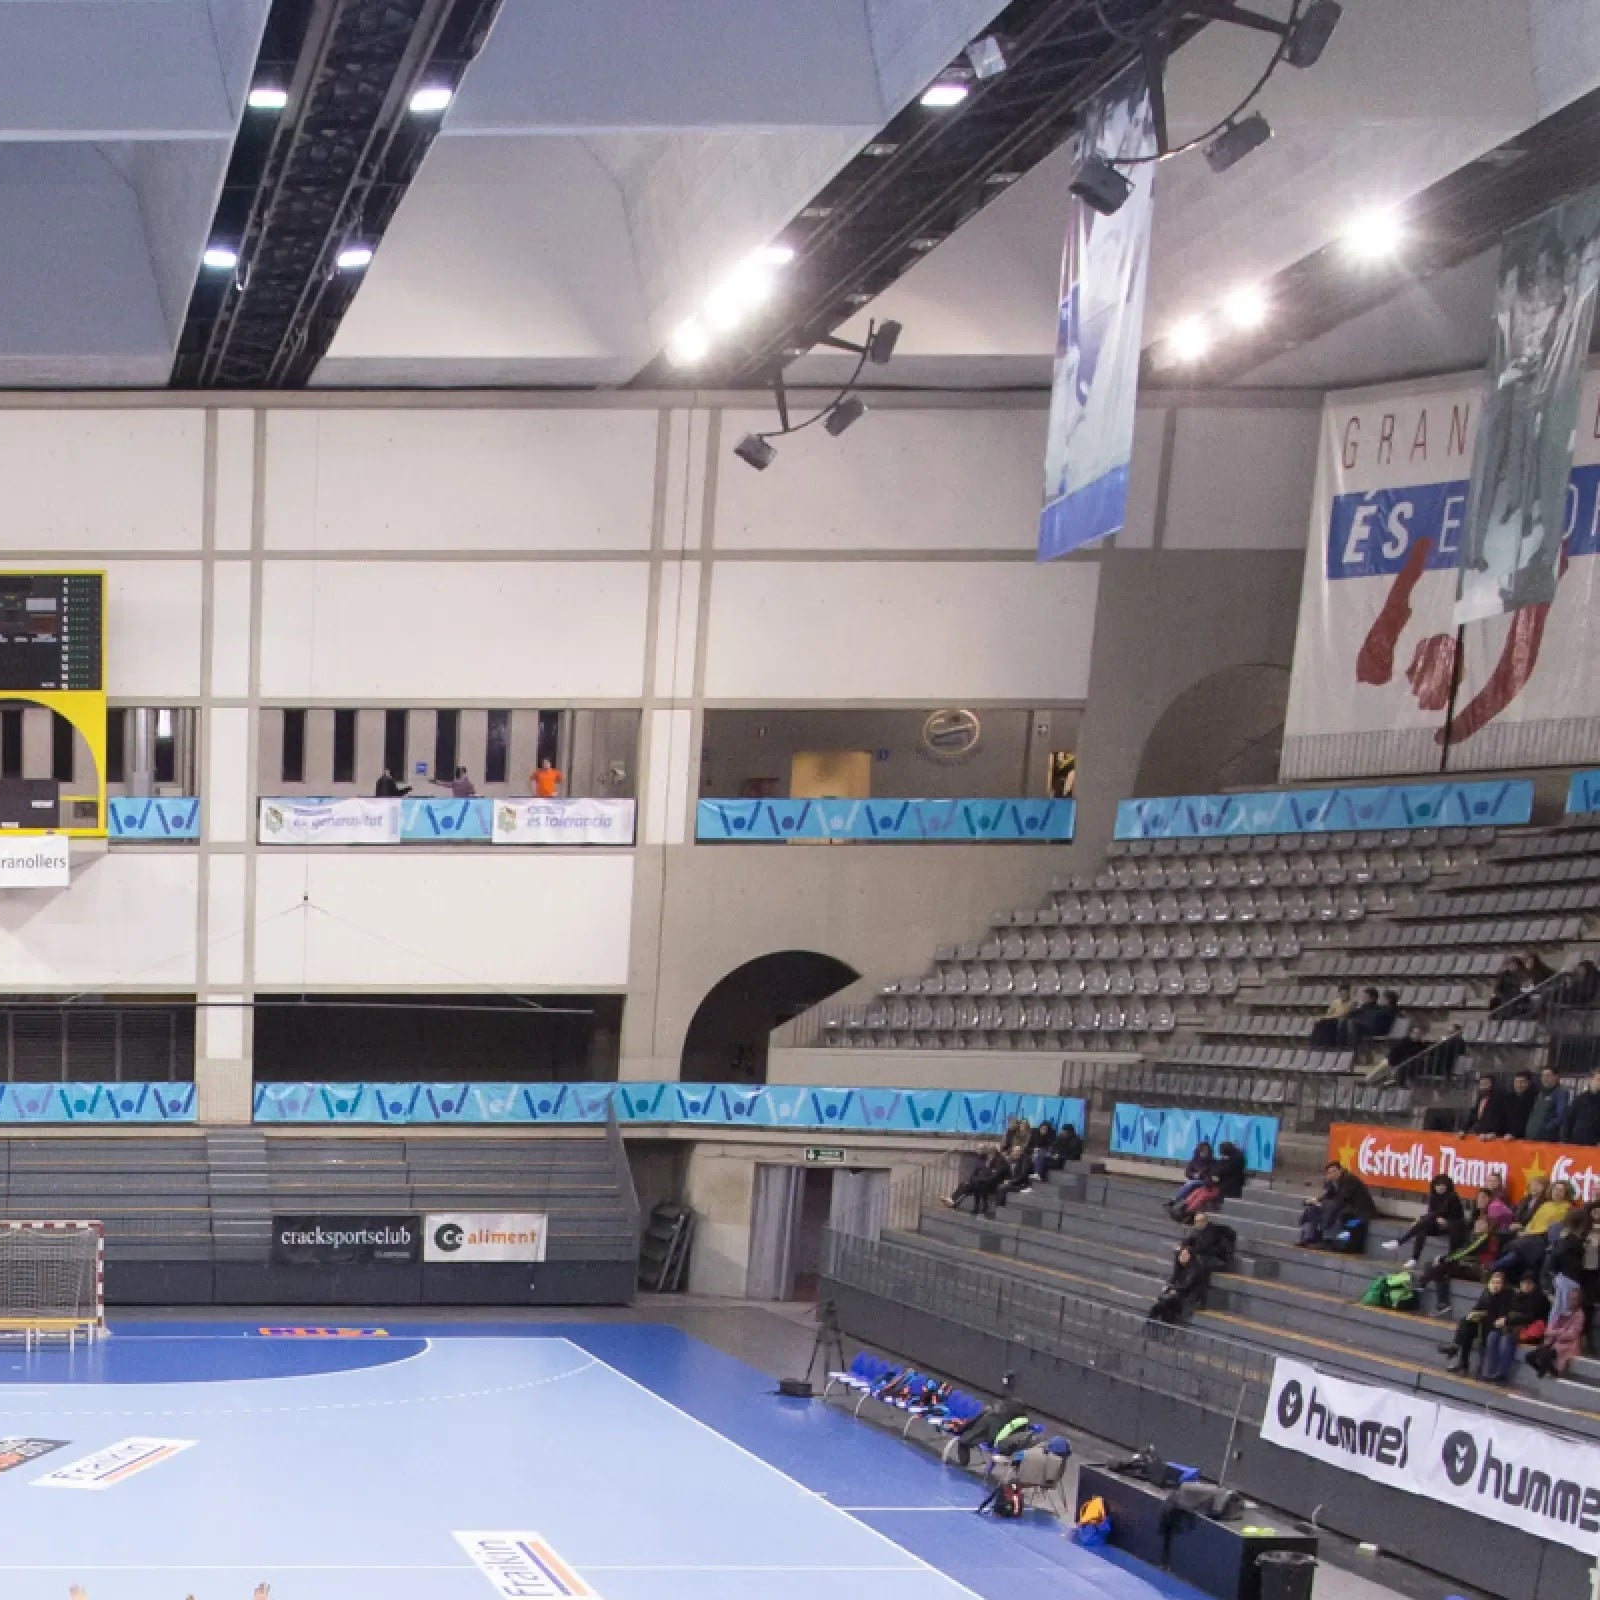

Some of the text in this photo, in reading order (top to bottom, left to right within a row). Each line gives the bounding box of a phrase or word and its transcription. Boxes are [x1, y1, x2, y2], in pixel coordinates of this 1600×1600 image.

[1358, 1135, 1433, 1181] Estrella
[281, 1226, 411, 1248] cracksportsclub
[1306, 1387, 1413, 1469] hummel
